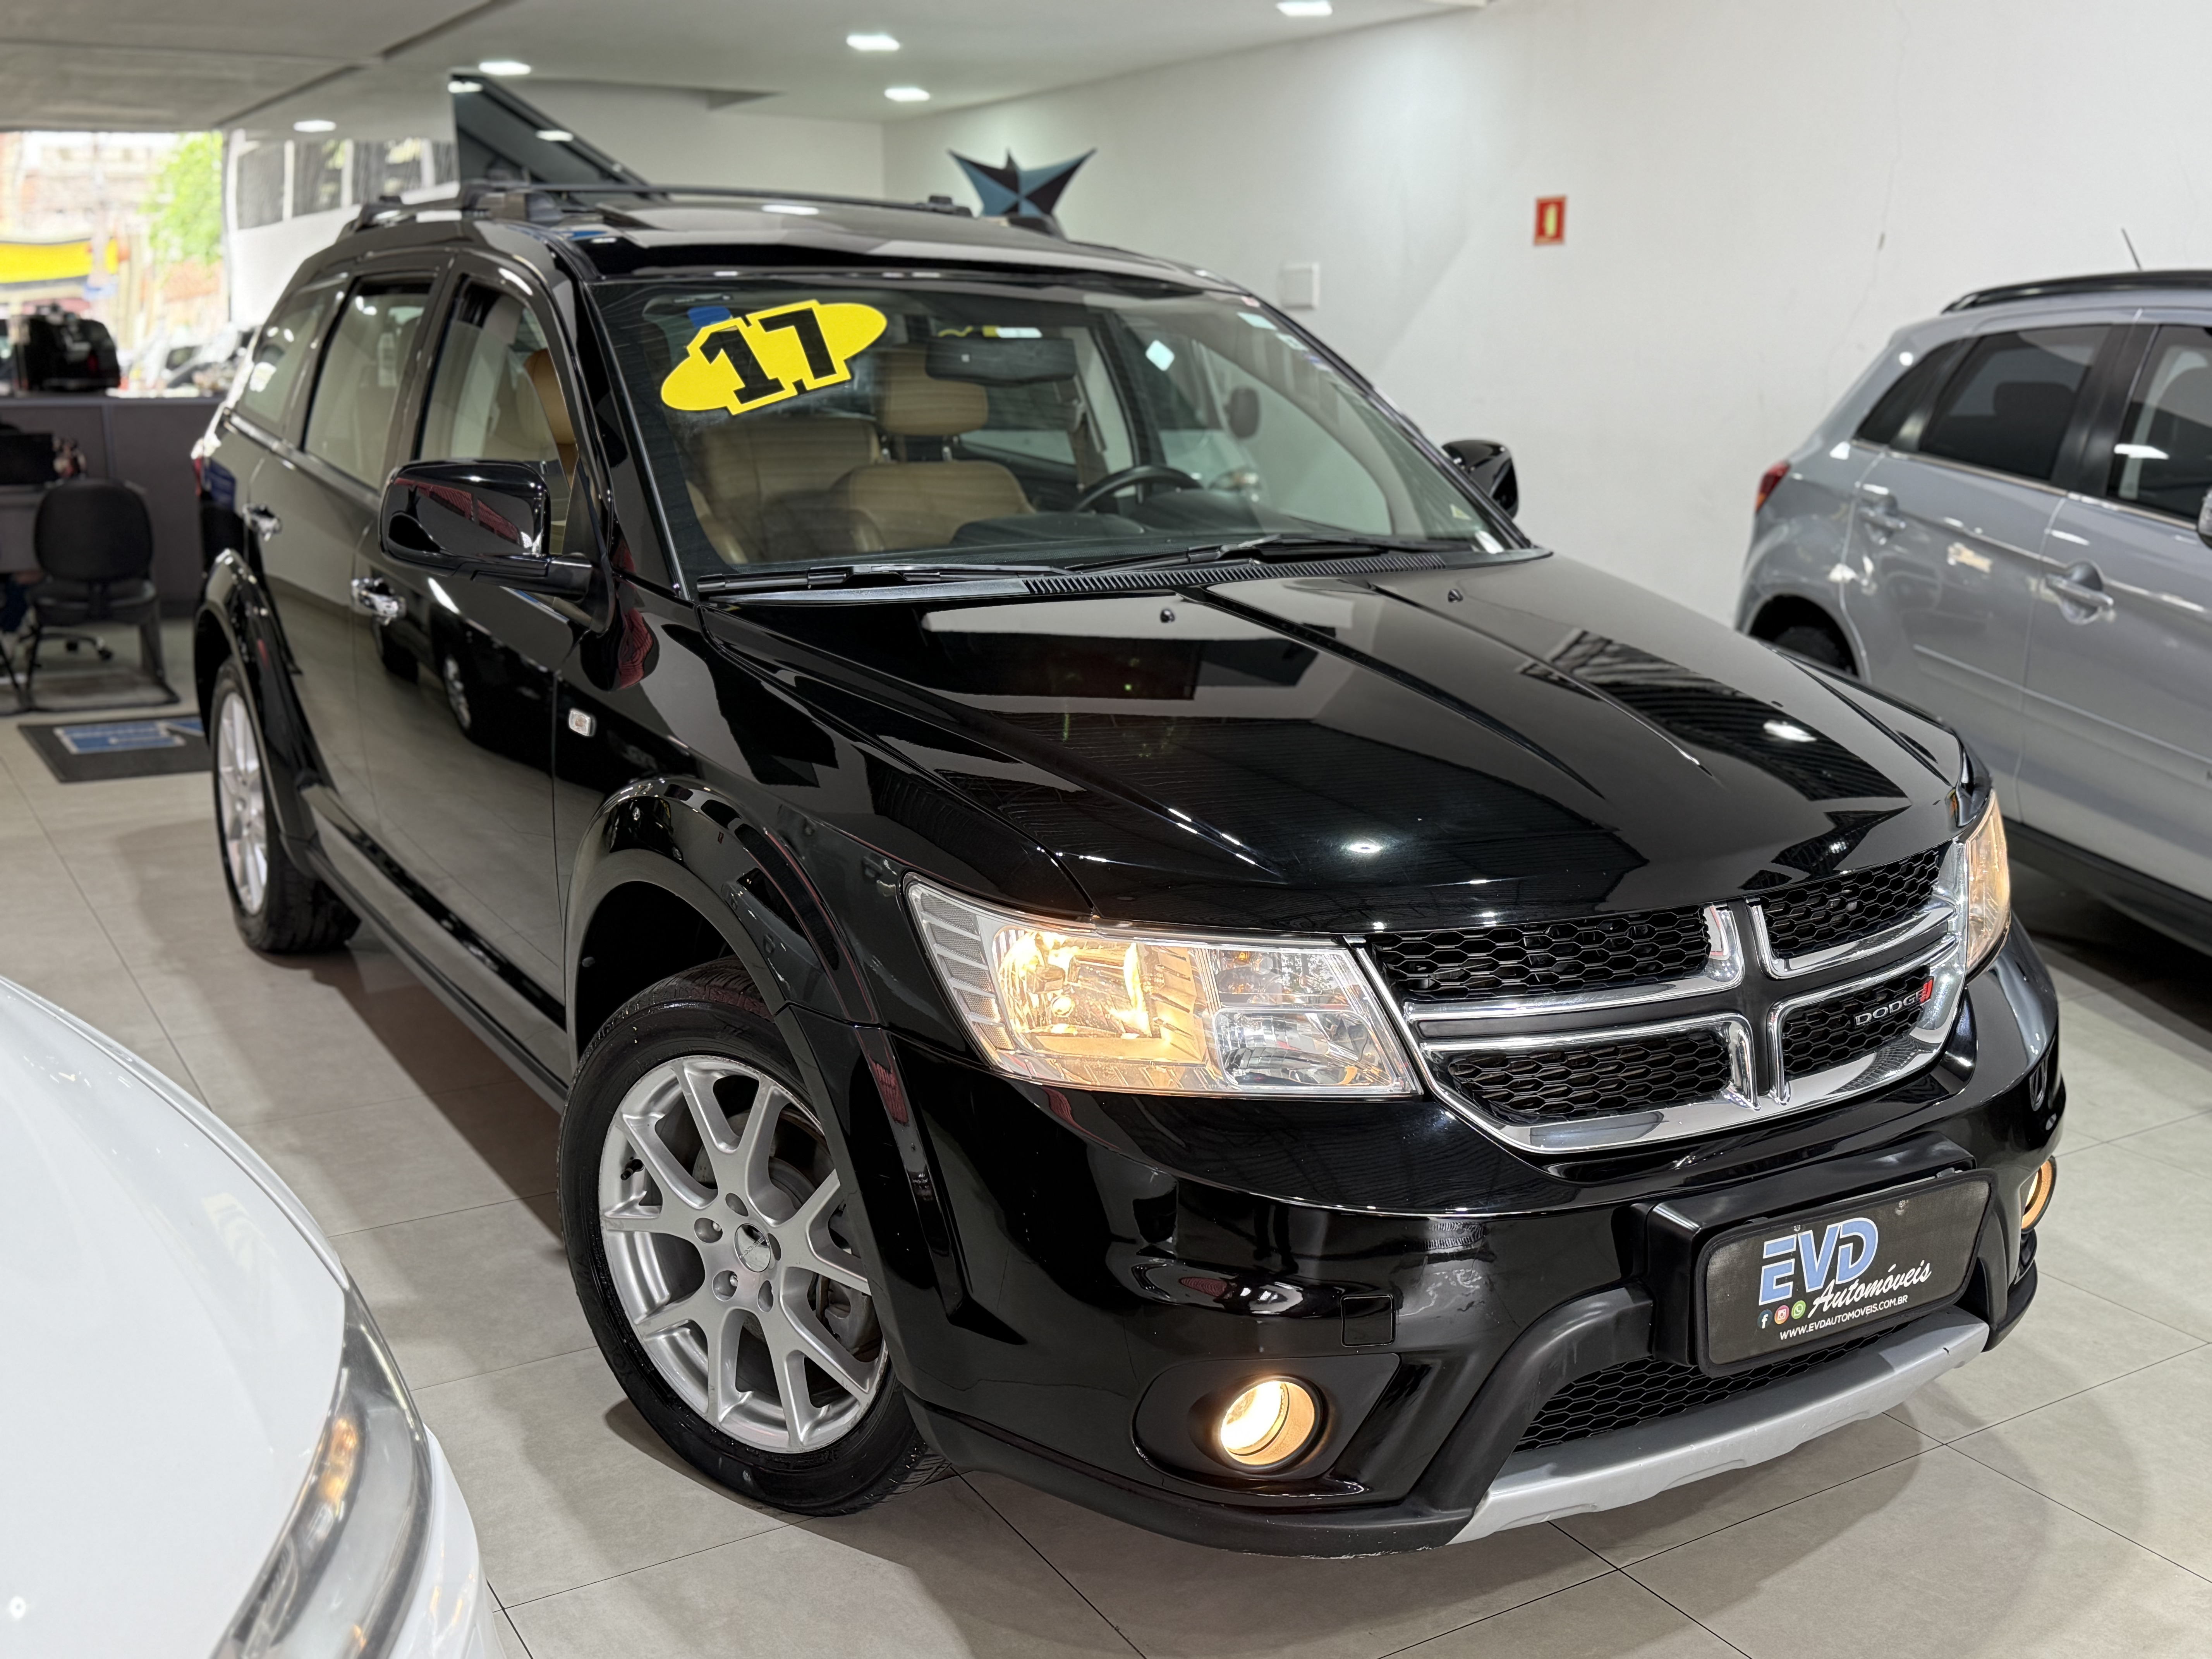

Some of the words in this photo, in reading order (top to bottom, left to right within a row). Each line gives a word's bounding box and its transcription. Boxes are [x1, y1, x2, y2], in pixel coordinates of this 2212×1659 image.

[699, 307, 838, 405] 17
[1855, 988, 1926, 1026] DODGE
[1759, 1217, 1878, 1305] EVD
[1808, 1260, 1932, 1318] Automóveis
[1779, 1294, 1908, 1340] WWW.EVDAUTOMOVEIS.COM.BR
